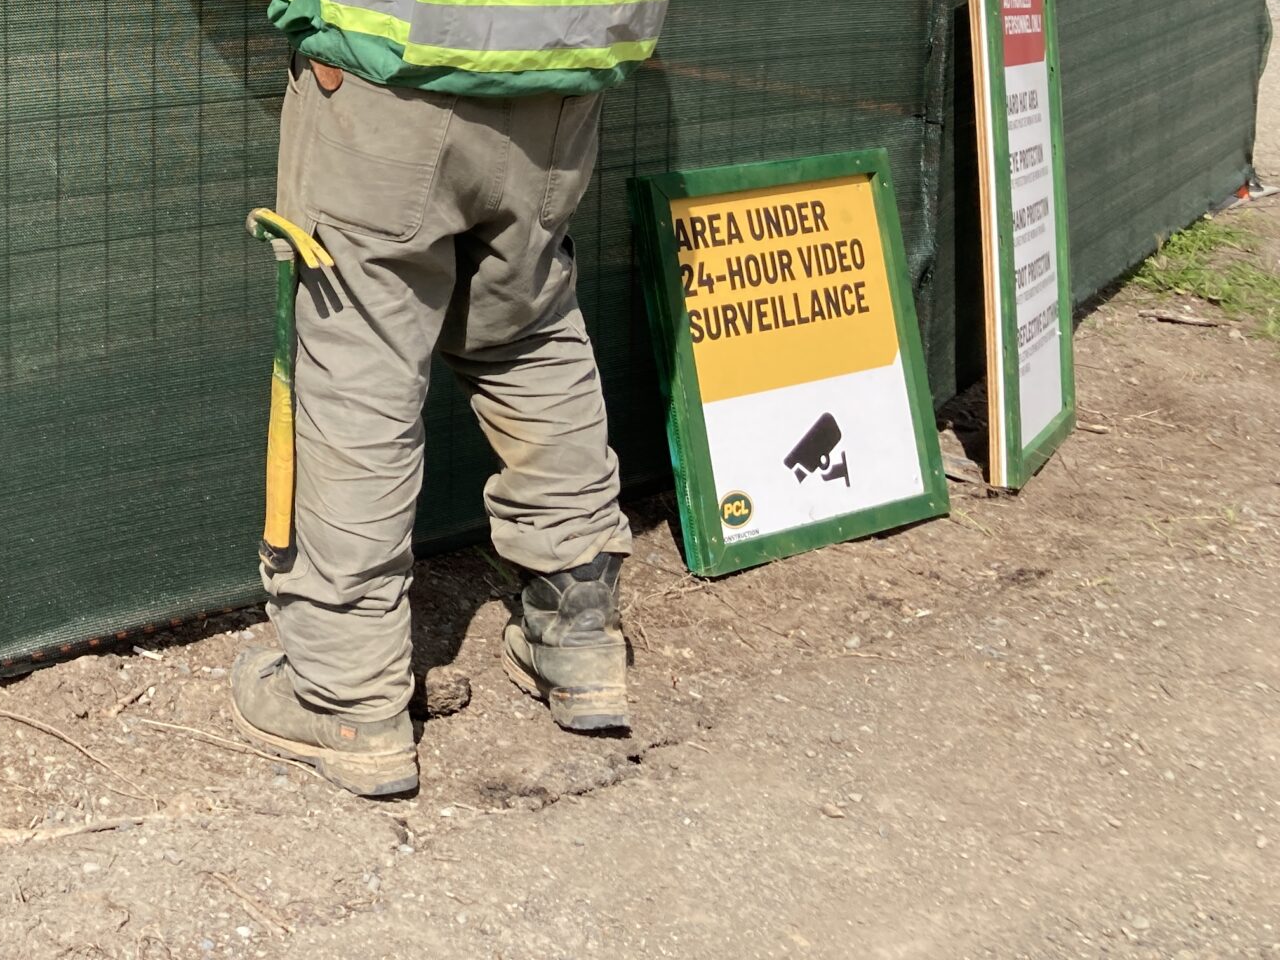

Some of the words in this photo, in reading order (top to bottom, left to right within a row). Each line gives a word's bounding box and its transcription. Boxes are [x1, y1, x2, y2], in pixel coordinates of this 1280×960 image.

[1004, 14, 1032, 35] PERSONNEL
[1031, 14, 1042, 33] ONLY
[1019, 91, 1028, 113] HAT
[1028, 89, 1039, 111] AREA
[1019, 143, 1044, 170] PROTECTION
[1026, 195, 1049, 227] PROTECTION
[675, 211, 744, 253] AREA
[746, 200, 829, 241] UNDER
[680, 249, 796, 298] 24-HOUR
[797, 238, 865, 279] VIDEO
[1027, 250, 1050, 285] PROTECTION
[688, 281, 870, 344] SURVEILLANCE
[723, 500, 749, 519] PCL
[723, 528, 760, 543] ONSTRUCTION
